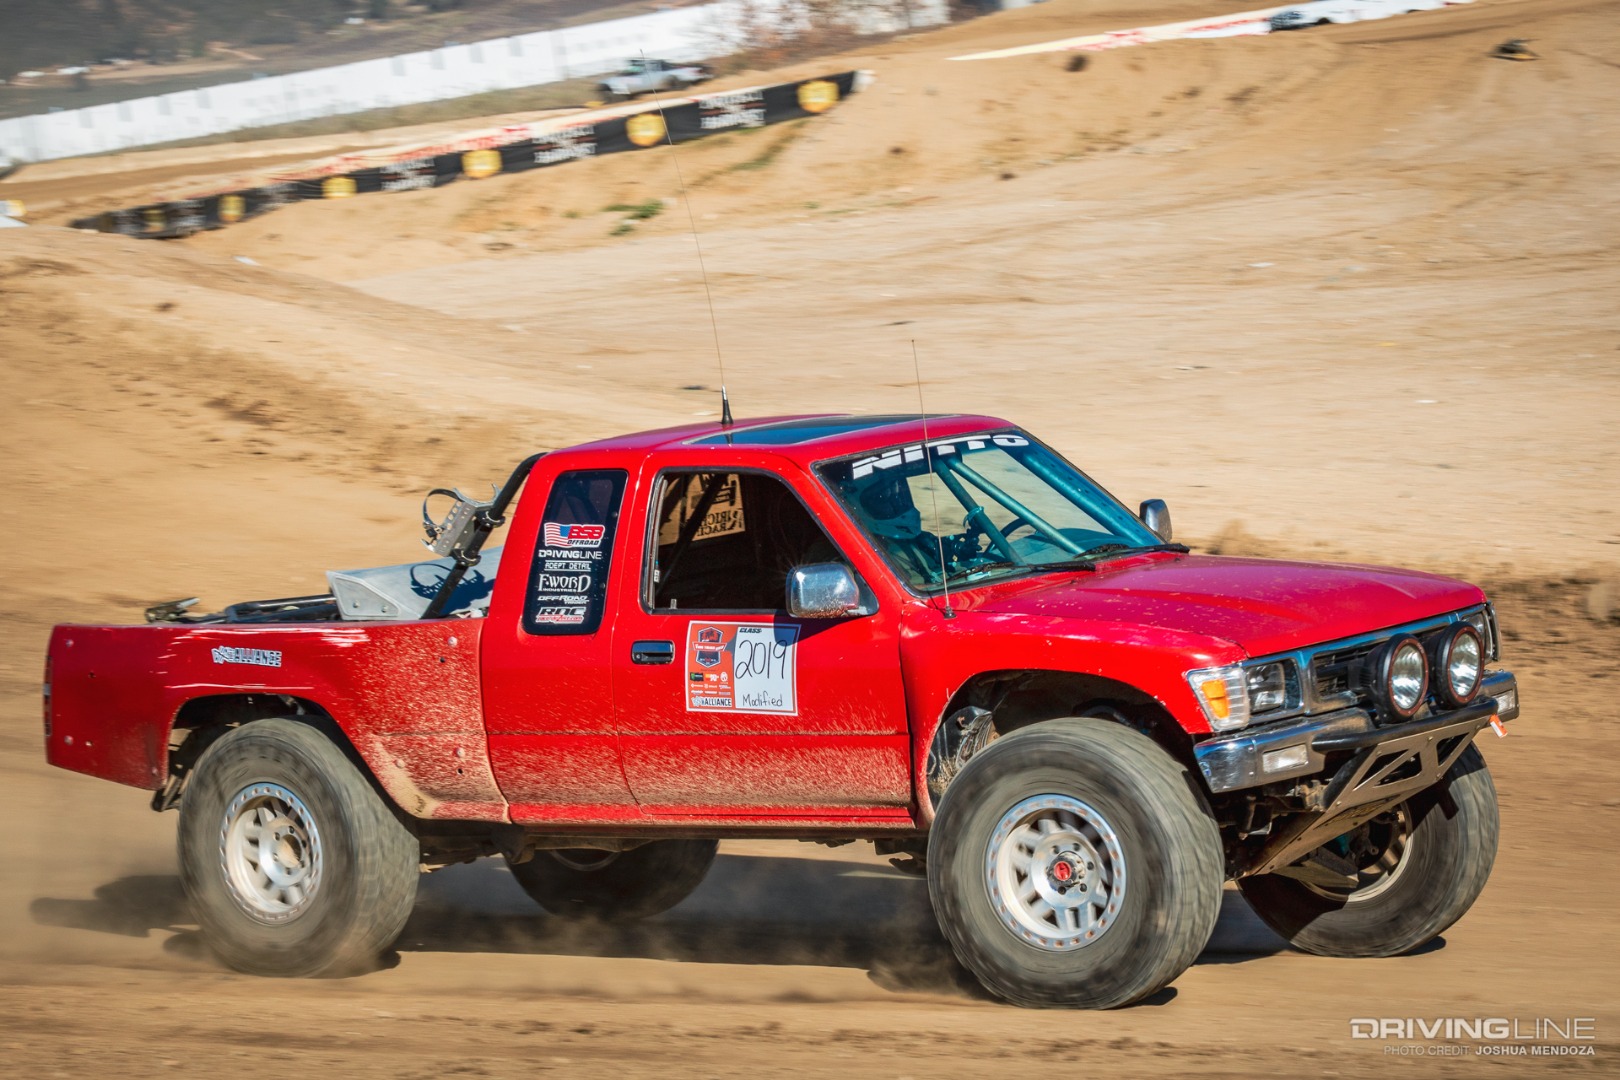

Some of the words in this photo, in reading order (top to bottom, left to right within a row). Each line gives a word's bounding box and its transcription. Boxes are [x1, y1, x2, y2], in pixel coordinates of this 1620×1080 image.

[852, 434, 1030, 480] NITTO
[538, 549, 603, 560] DRIVINGLINE
[545, 562, 566, 570] ADEPT
[568, 562, 590, 570] DETAIL
[735, 639, 788, 680] 2019
[742, 690, 783, 708] Modified
